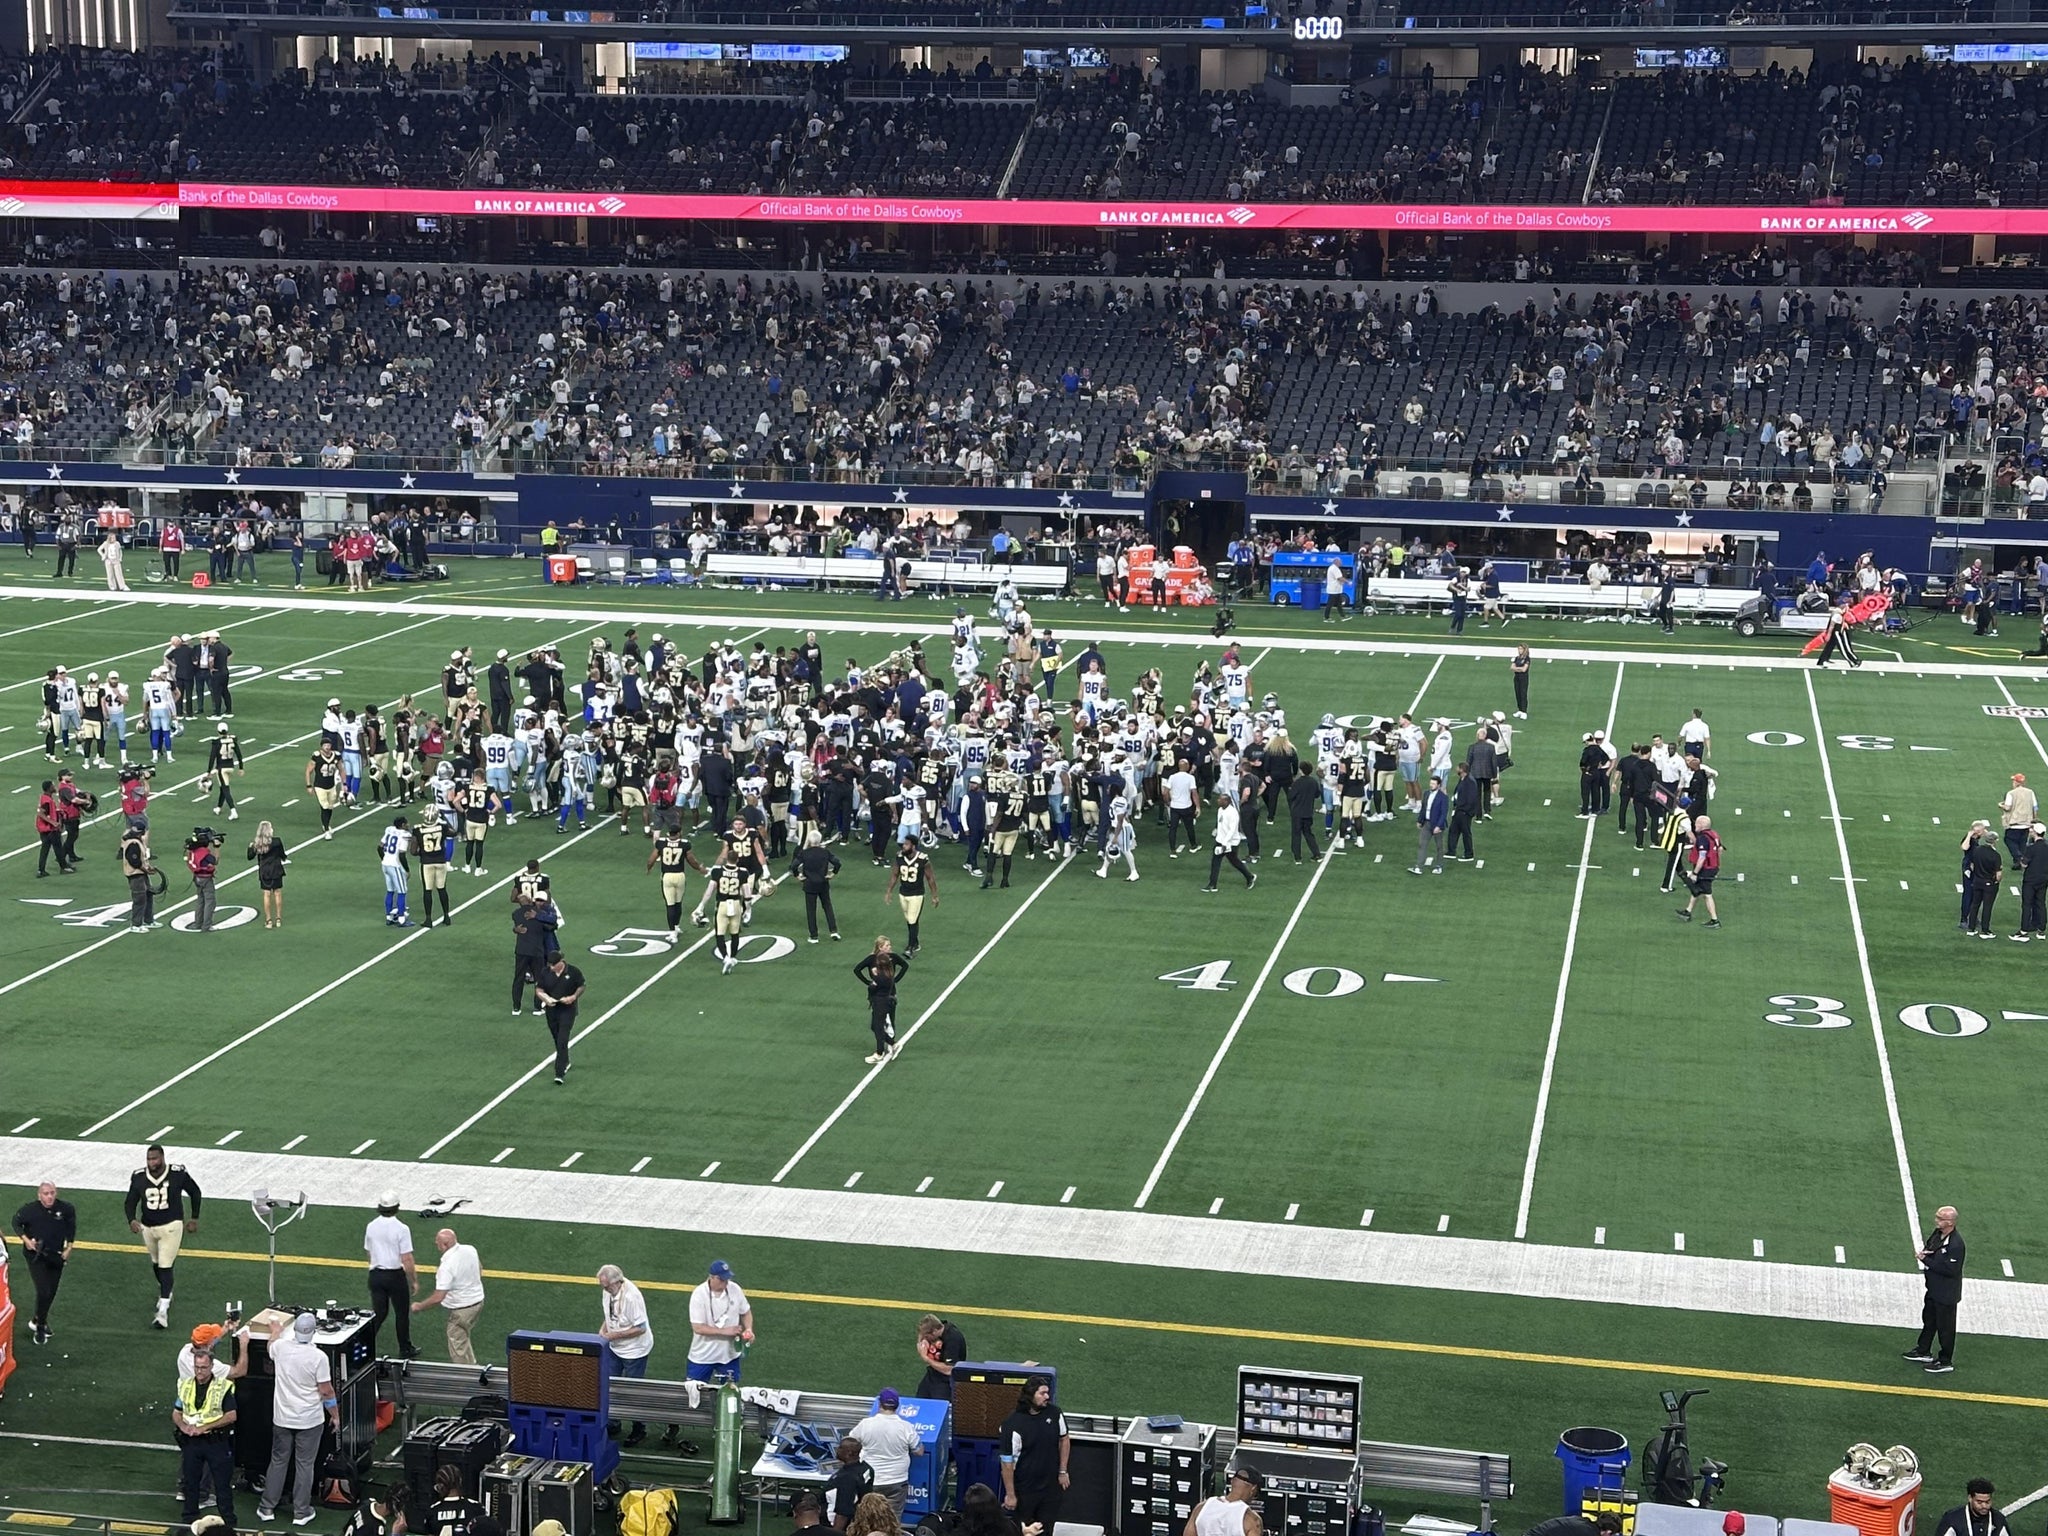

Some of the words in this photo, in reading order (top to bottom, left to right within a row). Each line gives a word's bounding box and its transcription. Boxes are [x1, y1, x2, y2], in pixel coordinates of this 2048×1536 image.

[179, 190, 208, 203] Bank
[210, 190, 225, 203] of
[227, 190, 246, 204] the
[249, 191, 283, 205] Dallas
[287, 191, 338, 208] Cowboys
[475, 200, 511, 211] BANK
[515, 201, 531, 211] OF
[534, 201, 596, 213] AMERICA
[760, 202, 801, 215] Official
[805, 203, 833, 216] Bank
[836, 203, 848, 216] of
[852, 204, 871, 217] the
[874, 204, 908, 218] Dallas
[911, 205, 962, 221] Cowboys
[1100, 211, 1138, 223] BANK
[1141, 212, 1158, 223] OF
[1161, 212, 1224, 224] AMERICA
[1395, 211, 1440, 224] Official
[1443, 212, 1472, 225] Bank
[1476, 212, 1490, 225] of
[1493, 212, 1513, 225] the
[1516, 212, 1552, 226] Dallas
[1556, 213, 1611, 229] Cowboys
[1761, 217, 1802, 229] BANK
[1806, 217, 1826, 229] OF
[1828, 217, 1898, 230] AMERICA
[554, 562, 565, 576] G
[194, 575, 205, 585] 20
[1227, 674, 1242, 686] 75
[152, 689, 161, 703] 5
[933, 698, 944, 712] 81
[344, 732, 352, 746] 6
[1125, 740, 1142, 753] 68
[488, 747, 506, 763] 99
[968, 746, 984, 763] 95
[1011, 758, 1026, 774] 42
[1349, 762, 1366, 780] 75
[921, 765, 939, 785] 25
[1032, 779, 1046, 796] 11
[469, 790, 486, 808] 13
[1005, 799, 1023, 817] 70
[662, 847, 683, 866] 87
[733, 841, 752, 857] 96
[900, 865, 919, 882] 93
[719, 876, 739, 895] 82
[145, 1187, 169, 1211] 91
[437, 1510, 466, 1522] KAMAA
